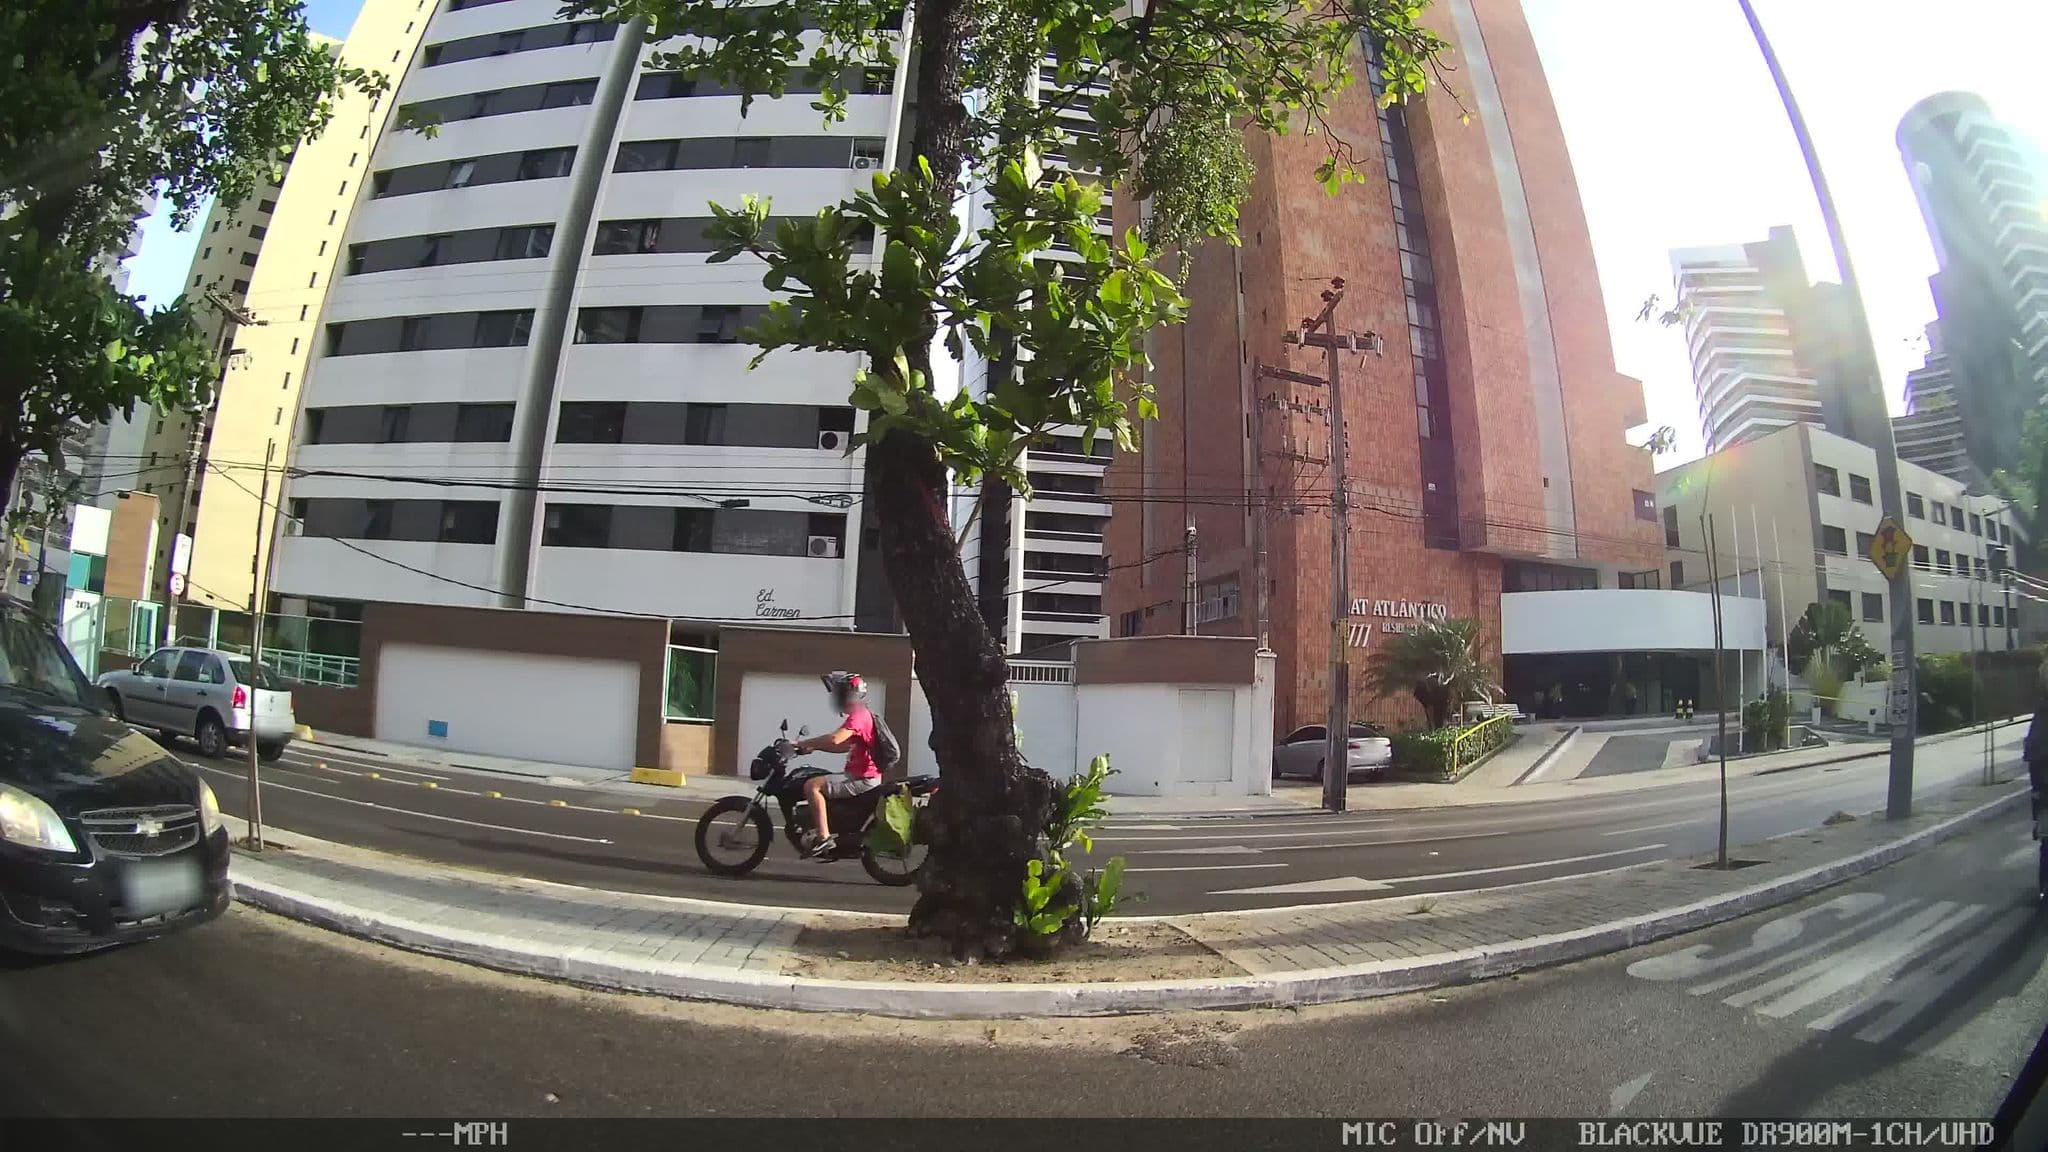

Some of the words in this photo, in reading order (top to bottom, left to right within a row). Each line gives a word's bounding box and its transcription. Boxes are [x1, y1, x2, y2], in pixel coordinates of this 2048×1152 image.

[756, 588, 775, 603] Ed.
[755, 602, 801, 618] Carmen
[1348, 598, 1369, 616] AT
